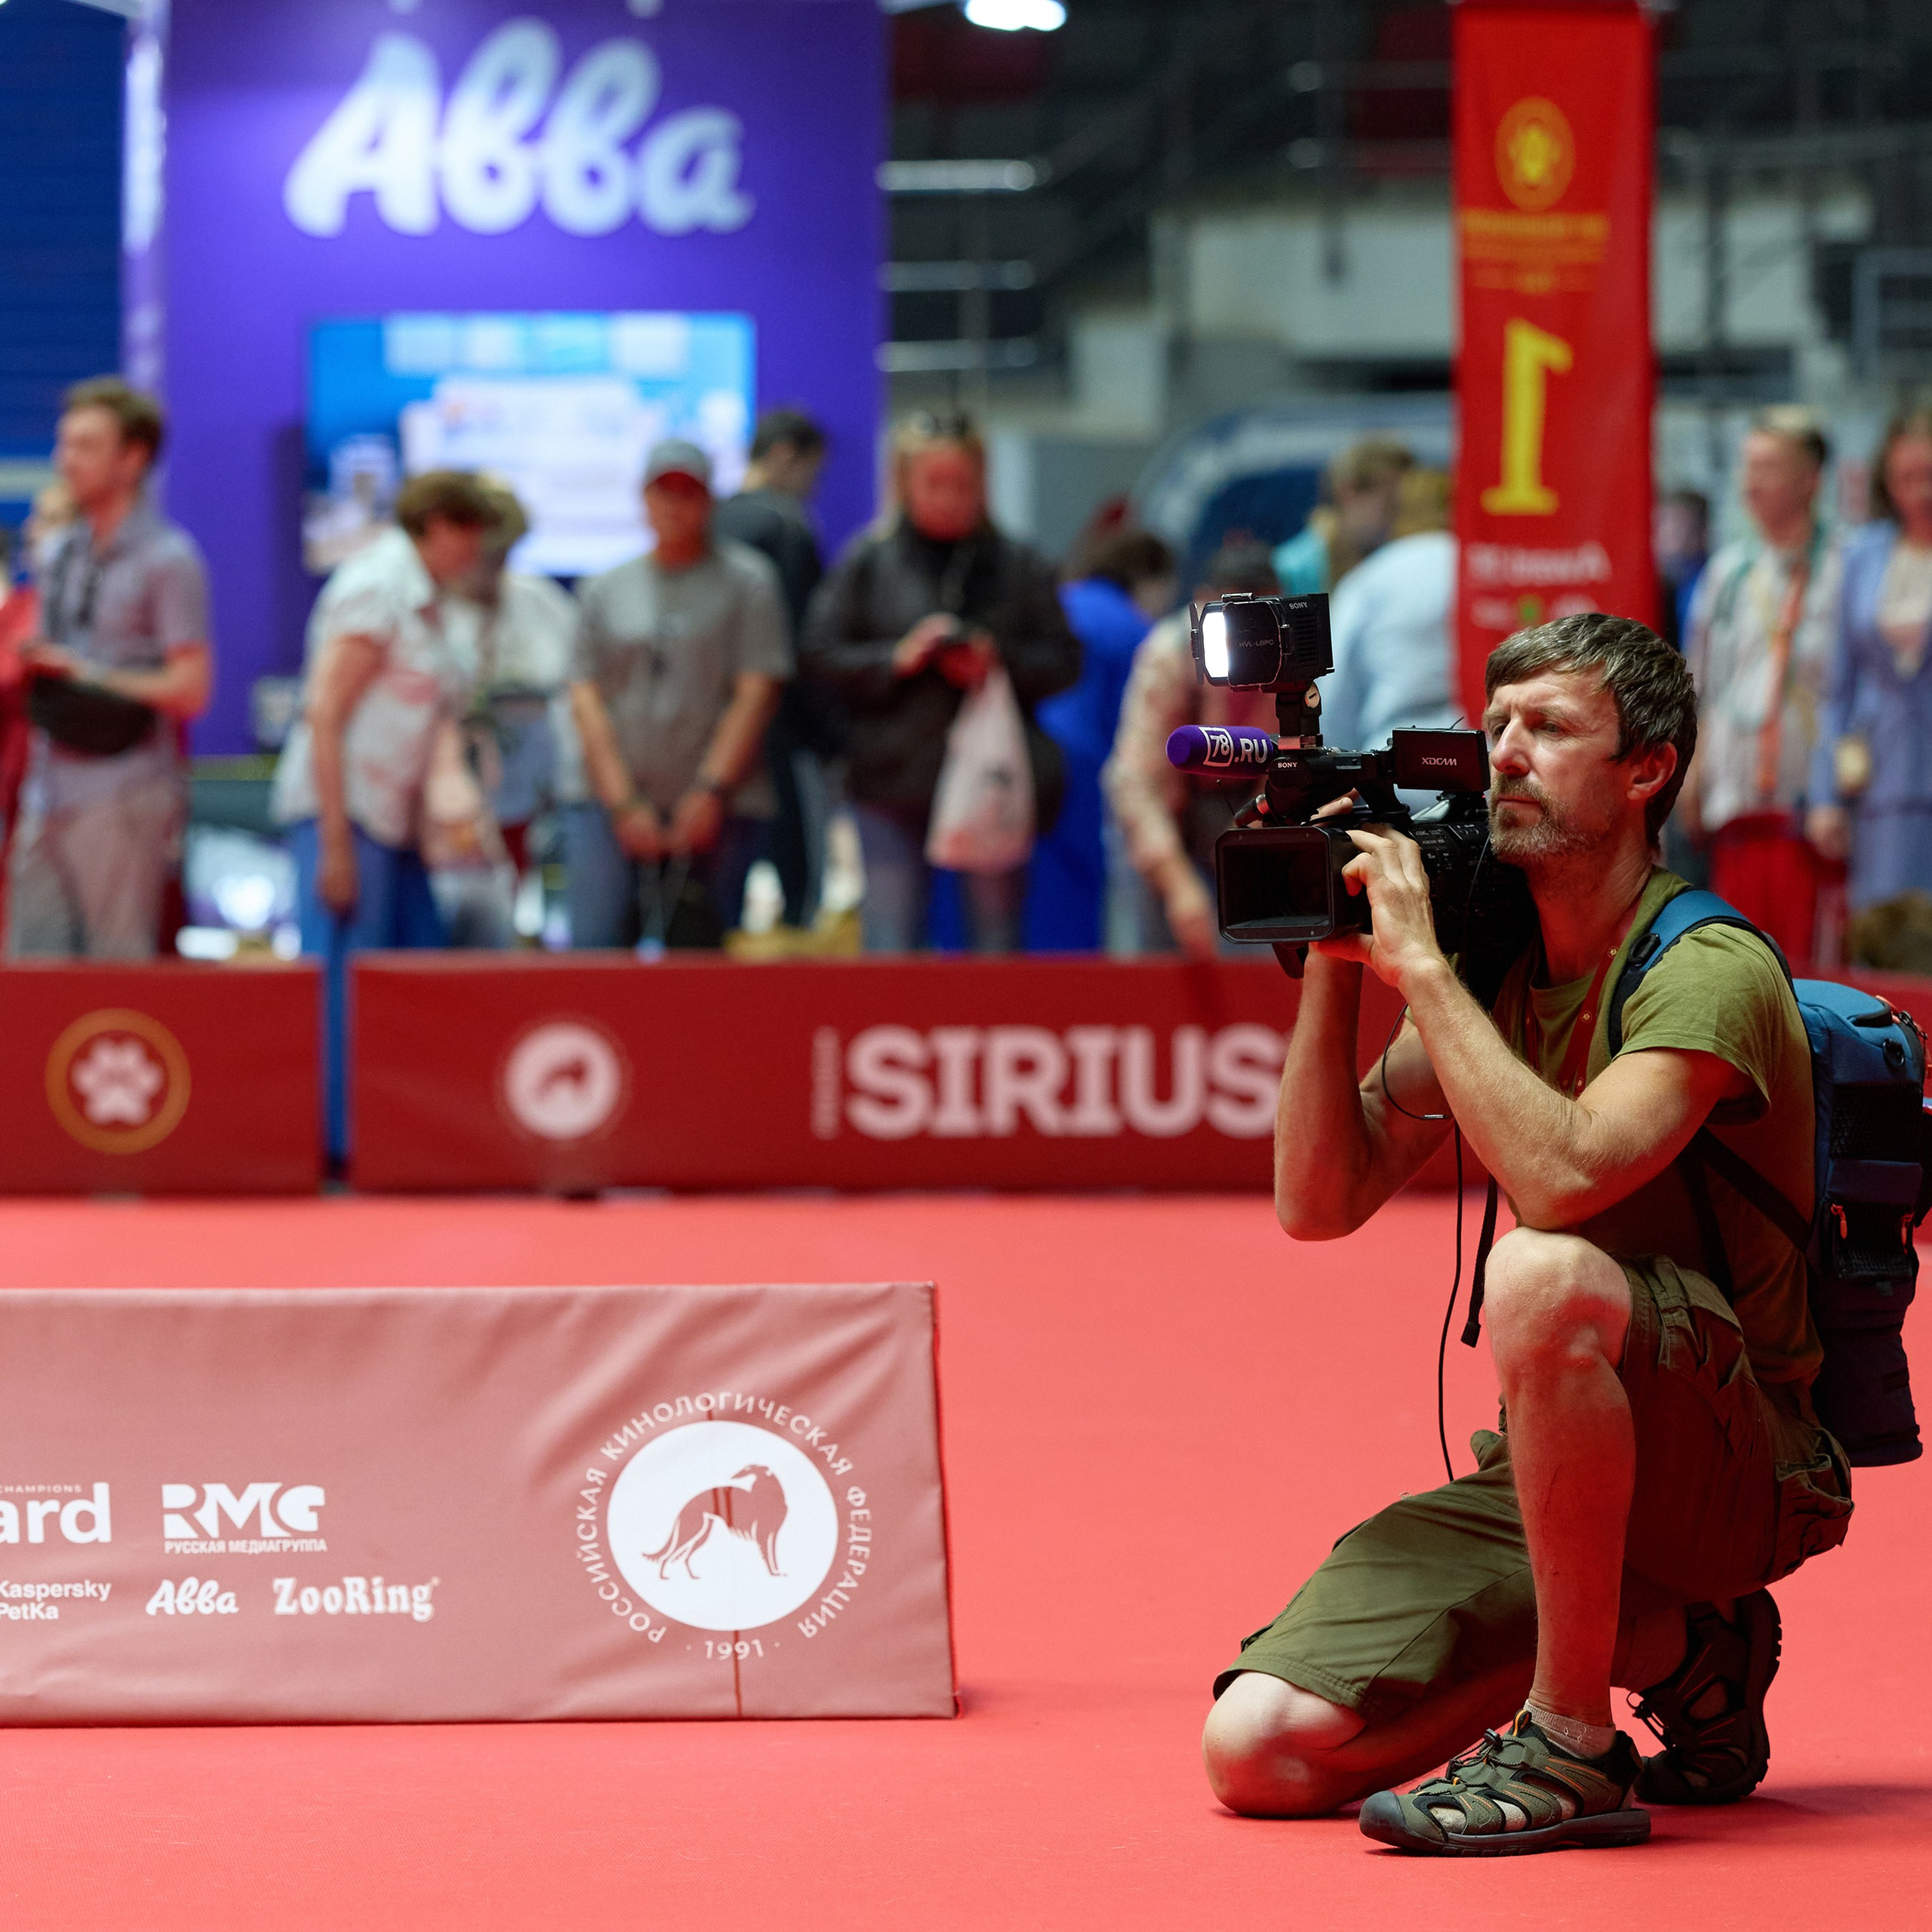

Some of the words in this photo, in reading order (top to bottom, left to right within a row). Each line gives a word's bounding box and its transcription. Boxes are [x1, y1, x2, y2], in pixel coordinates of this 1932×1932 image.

[1288, 601, 1308, 610] SONY
[1421, 757, 1457, 766] XDCAM
[846, 1023, 1287, 1140] SIRIUS
[600, 1391, 854, 1476] КИНОЛОГИЧЕСКАЯ
[165, 1540, 226, 1555] РУССКАЯ
[228, 1538, 328, 1555] МЕДИАГРУППА
[576, 1466, 667, 1644] РОССИЙСКАЯ
[797, 1485, 872, 1639] ФЕДЕРАЦИЯ
[272, 1576, 435, 1623] ZooRing
[704, 1638, 764, 1660] 1991
